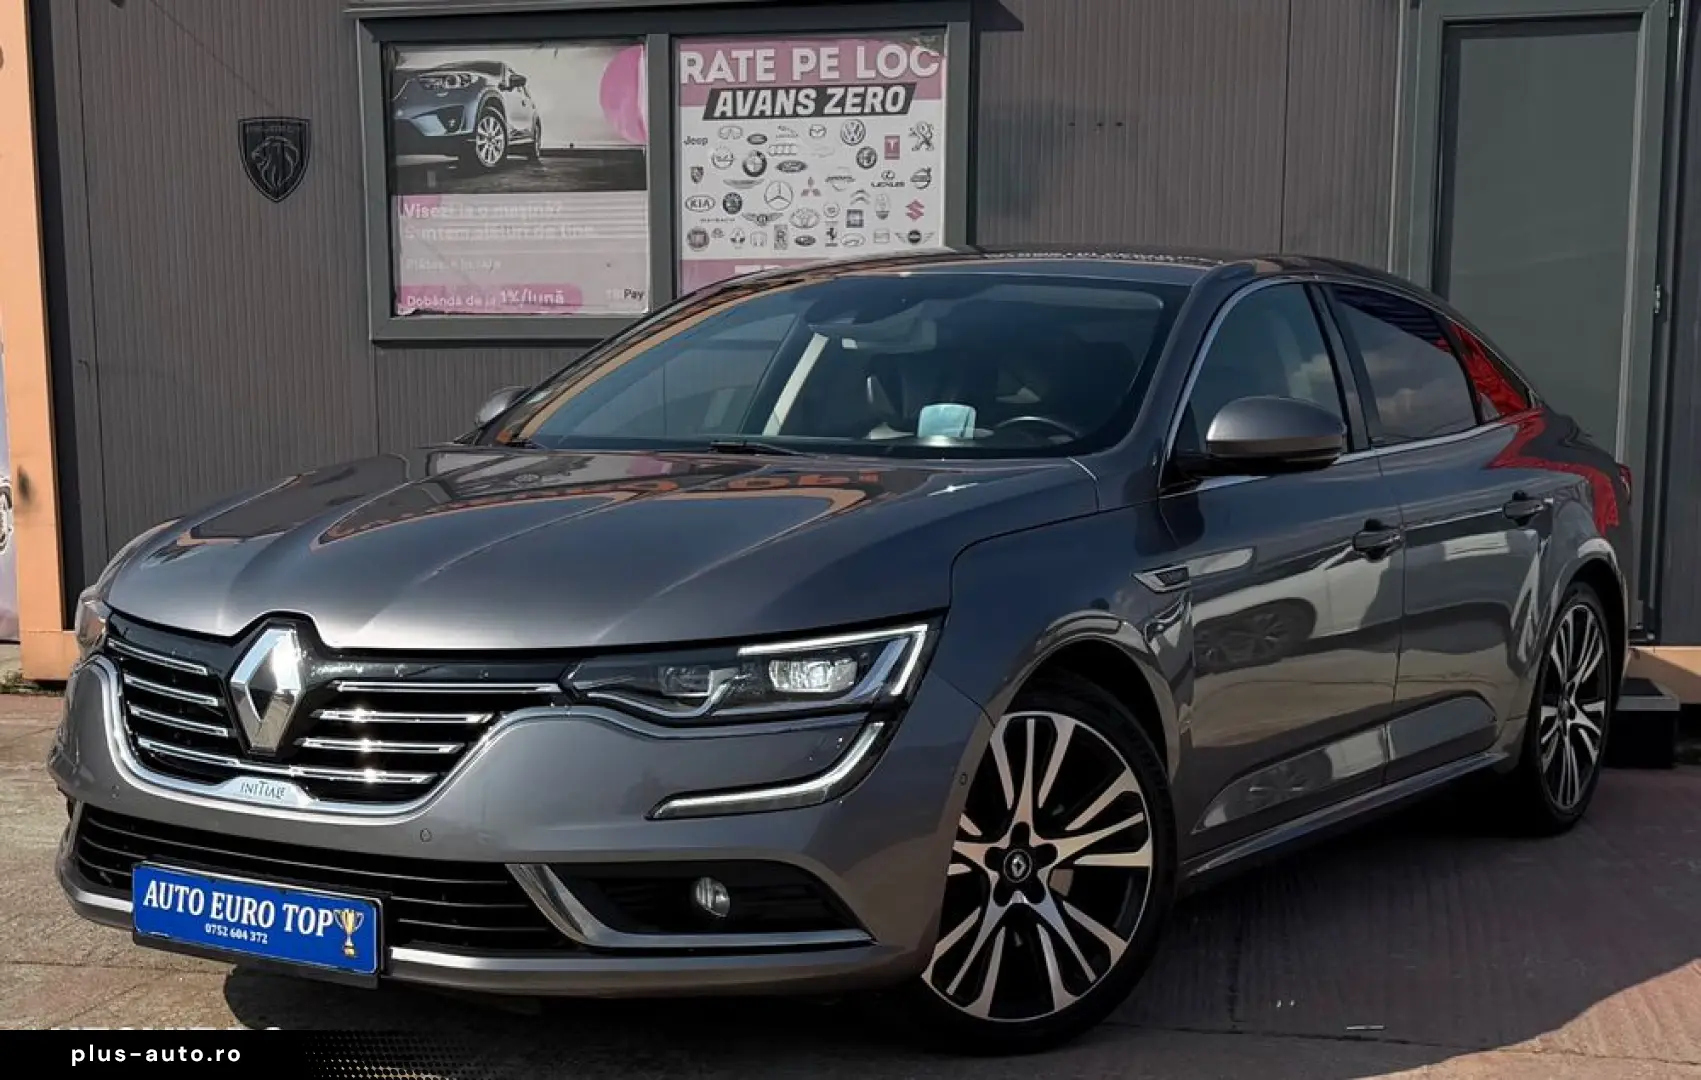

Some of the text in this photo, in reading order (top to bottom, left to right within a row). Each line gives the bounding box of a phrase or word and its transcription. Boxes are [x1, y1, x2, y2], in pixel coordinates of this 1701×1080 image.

[680, 44, 940, 84] RATE PE LOC
[713, 86, 906, 118] AVANS ZERO
[690, 200, 710, 208] KIA
[143, 880, 334, 937] AUTO EURO TOP
[204, 923, 268, 944] 0752 604 372
